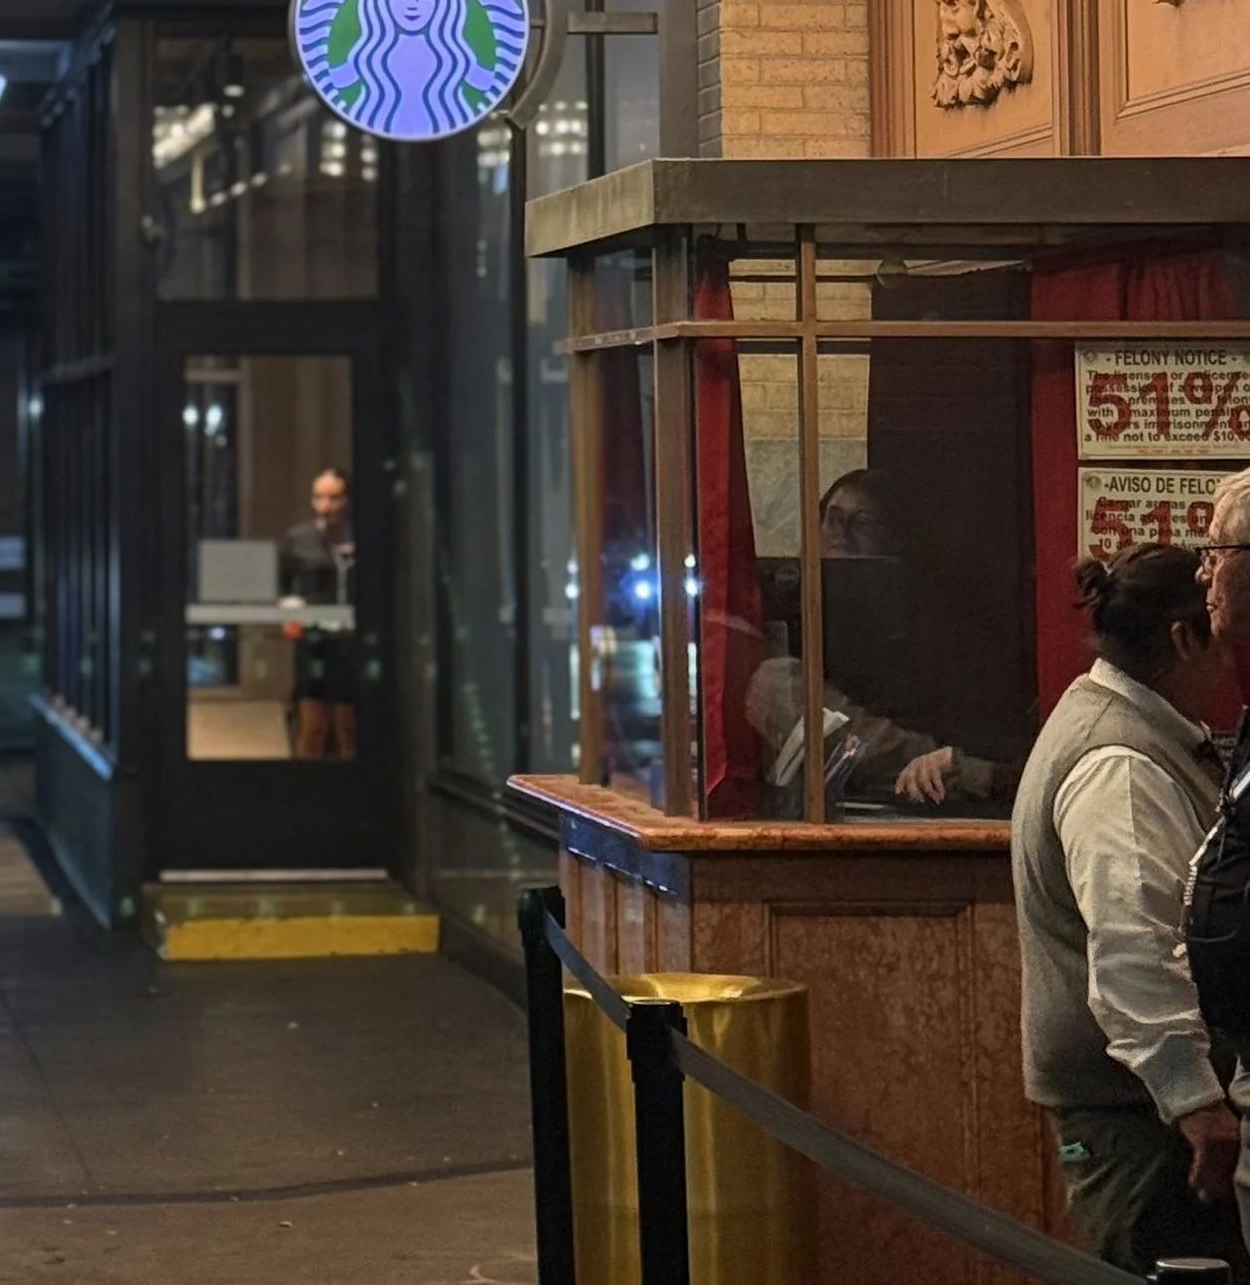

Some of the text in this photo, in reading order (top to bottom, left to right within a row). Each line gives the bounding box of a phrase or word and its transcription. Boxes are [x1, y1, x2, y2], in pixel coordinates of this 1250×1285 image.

[1115, 350, 1227, 365] FELONY NOTICE
[1124, 432, 1144, 442] not
[1110, 476, 1220, 495] AVISO DE FELO
